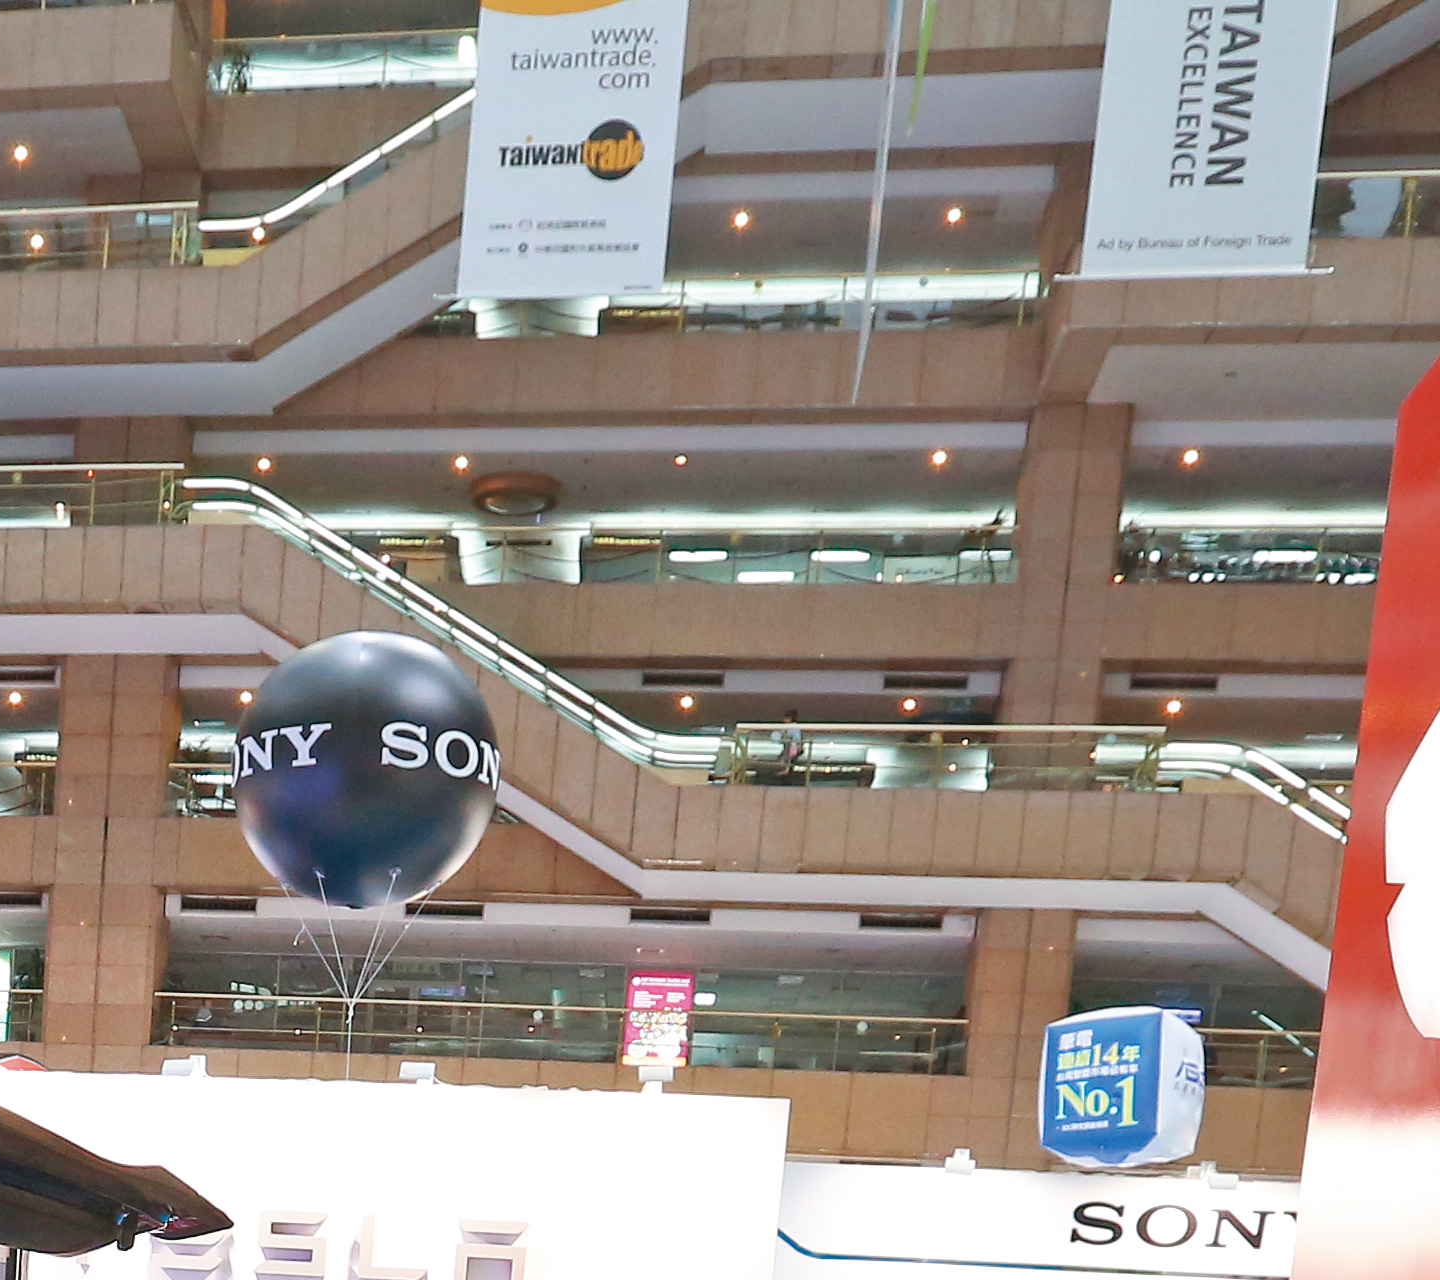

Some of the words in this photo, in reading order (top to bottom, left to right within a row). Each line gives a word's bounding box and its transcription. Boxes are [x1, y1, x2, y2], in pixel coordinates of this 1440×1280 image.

[591, 26, 659, 46] www.
[510, 45, 657, 71] taiwantrade.
[598, 71, 651, 90] com
[1169, 6, 1213, 188] EXCELLENCE
[1204, 0, 1263, 186] TAIWAN
[1097, 238, 1115, 250] Ad
[1118, 239, 1135, 252] by
[1138, 236, 1183, 249] Bureau
[1187, 235, 1201, 247] of
[1203, 234, 1252, 249] Foreign
[1256, 234, 1293, 246] Trade
[1055, 1075, 1140, 1128] No.1
[1070, 1200, 1298, 1250] SON
